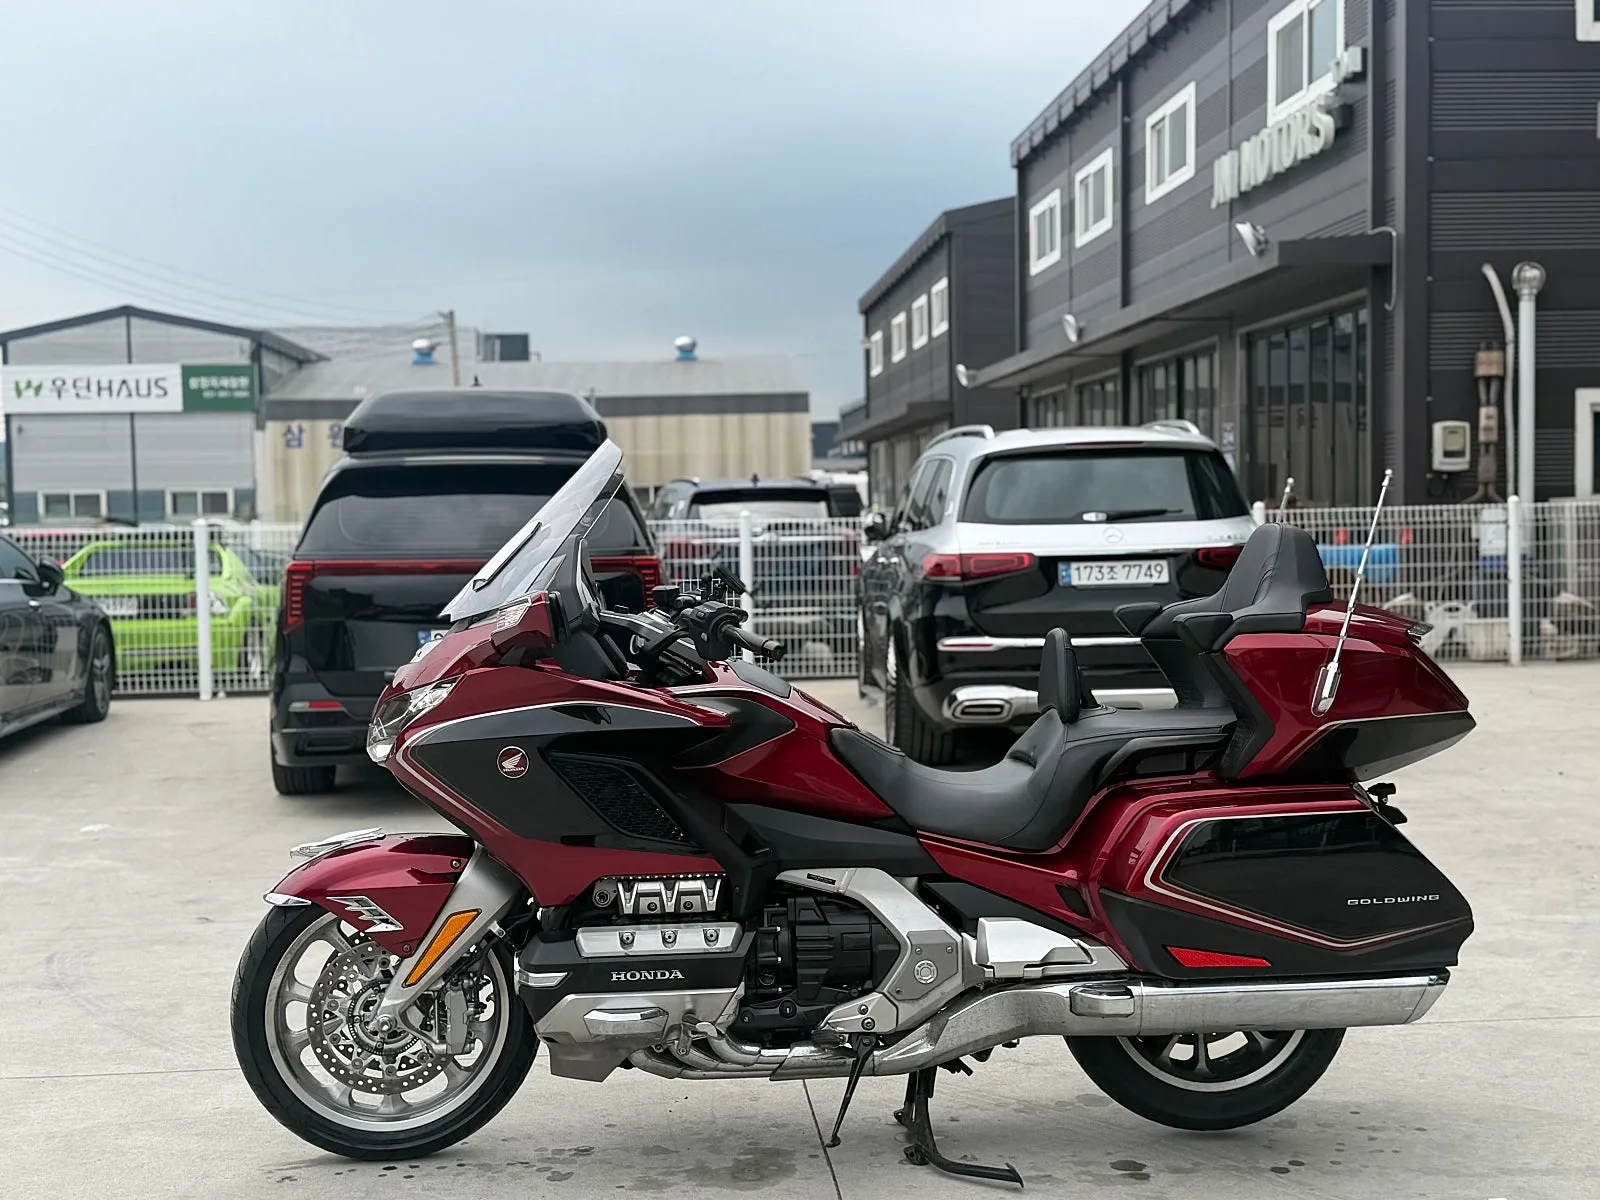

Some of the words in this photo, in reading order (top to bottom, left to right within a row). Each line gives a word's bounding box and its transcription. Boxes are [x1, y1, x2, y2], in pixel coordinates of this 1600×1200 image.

[1240, 105, 1335, 193] MOTORS
[1074, 564, 1118, 582] 173조
[1122, 563, 1164, 580] 7749
[1347, 894, 1440, 906] GOLDWING
[610, 969, 685, 981] HONDA
